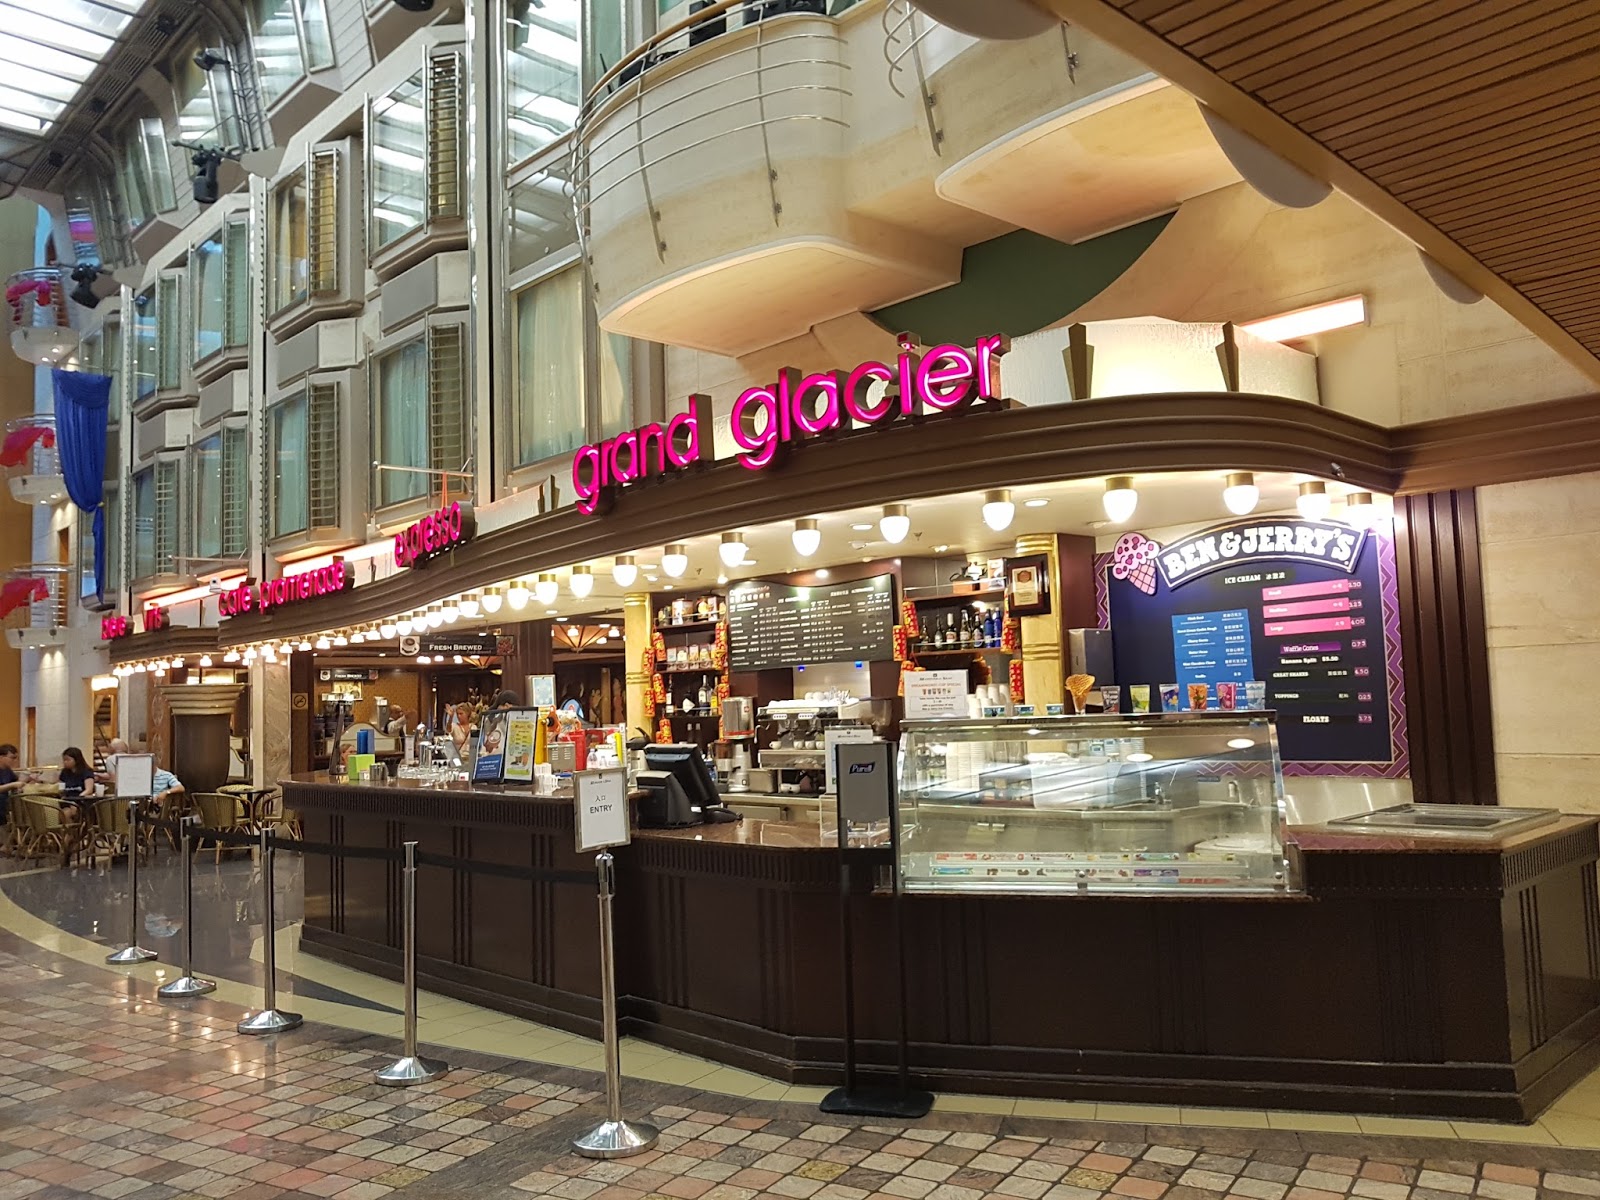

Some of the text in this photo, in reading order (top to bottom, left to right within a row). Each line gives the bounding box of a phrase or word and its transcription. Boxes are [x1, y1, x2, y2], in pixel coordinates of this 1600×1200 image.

[572, 332, 1004, 515] grand glacier
[1162, 525, 1356, 580] BEN & JERRY'S
[260, 560, 346, 615] promenade
[1224, 573, 1261, 585] ICE CREAM
[1302, 715, 1330, 723] FLOATS
[589, 803, 613, 814] ENTRY
